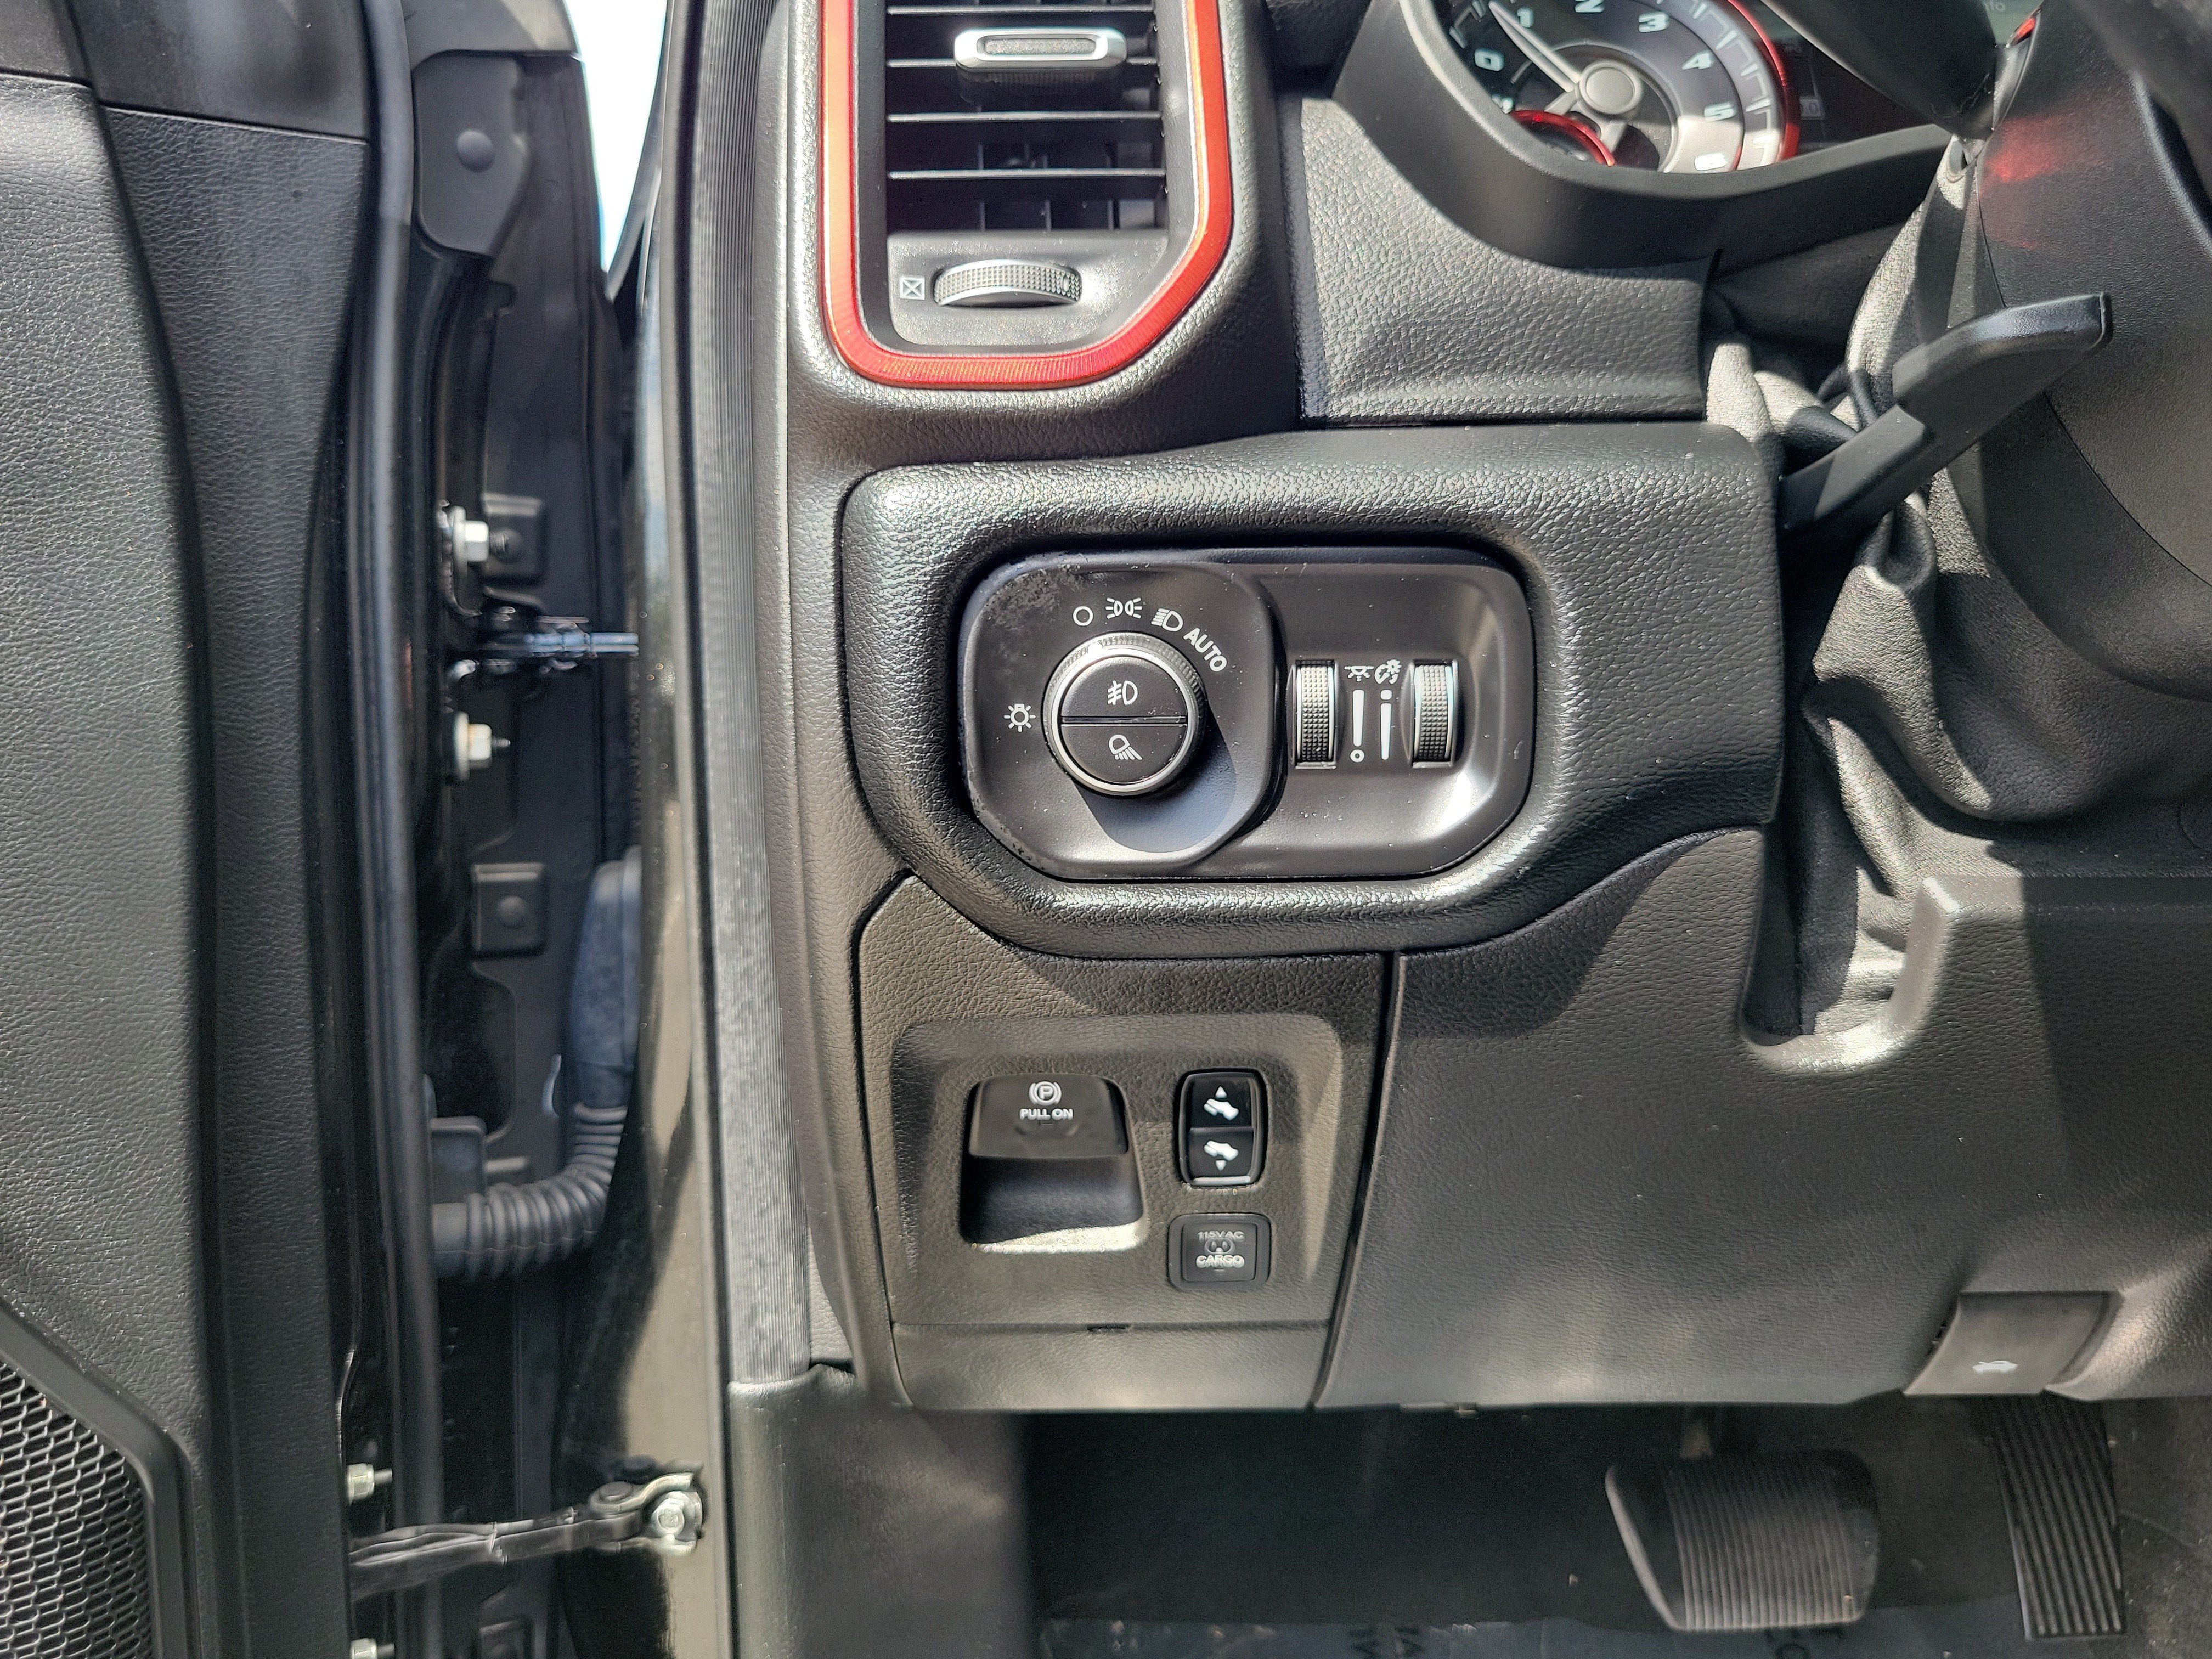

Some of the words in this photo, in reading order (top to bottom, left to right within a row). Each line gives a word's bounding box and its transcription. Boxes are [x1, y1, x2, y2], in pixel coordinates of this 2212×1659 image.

[1516, 7, 1534, 28] 1
[1638, 12, 1669, 33] 3
[1474, 47, 1504, 71] 0
[1681, 50, 1714, 70] 4
[1703, 101, 1737, 122] 5
[1183, 628, 1227, 672] AUTO
[1019, 1108, 1051, 1120] PULL
[1052, 1108, 1074, 1120] ON
[1196, 1254, 1245, 1268] CARGO
